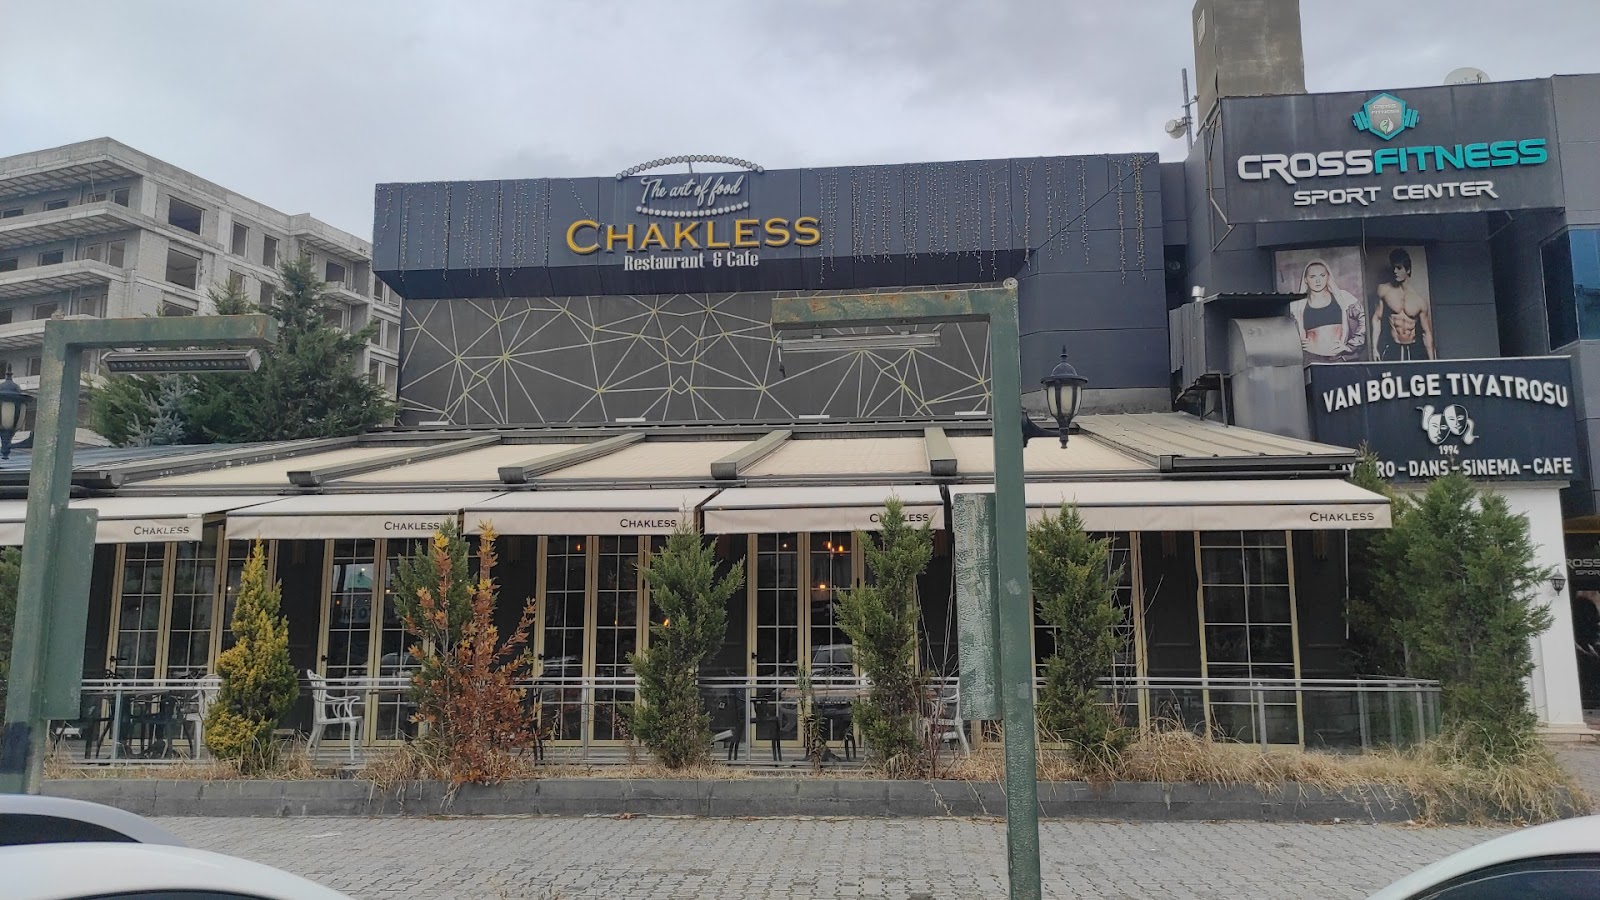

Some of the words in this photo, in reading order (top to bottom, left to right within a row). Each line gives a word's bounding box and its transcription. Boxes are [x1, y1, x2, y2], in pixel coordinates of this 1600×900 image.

[640, 176, 668, 204] The
[669, 178, 696, 198] art
[693, 175, 713, 207] of
[707, 174, 745, 207] food
[1293, 186, 1382, 206] SPORT
[1392, 180, 1499, 201] CENTER
[566, 217, 821, 254] CHAKLESS
[624, 252, 706, 271] Restaurant
[712, 251, 723, 268] &
[727, 250, 759, 267] Cafe
[1323, 382, 1362, 413] VAN
[1366, 371, 1441, 403] BÖLGE
[1438, 445, 1460, 455] 1994
[1408, 460, 1449, 477] DANS
[1533, 457, 1573, 474] CAFE
[384, 521, 440, 530] CHAKLESS
[619, 518, 677, 528] CHAKLESS
[1309, 512, 1375, 522] CHAKLESS
[133, 526, 190, 535] CHAKLESS
